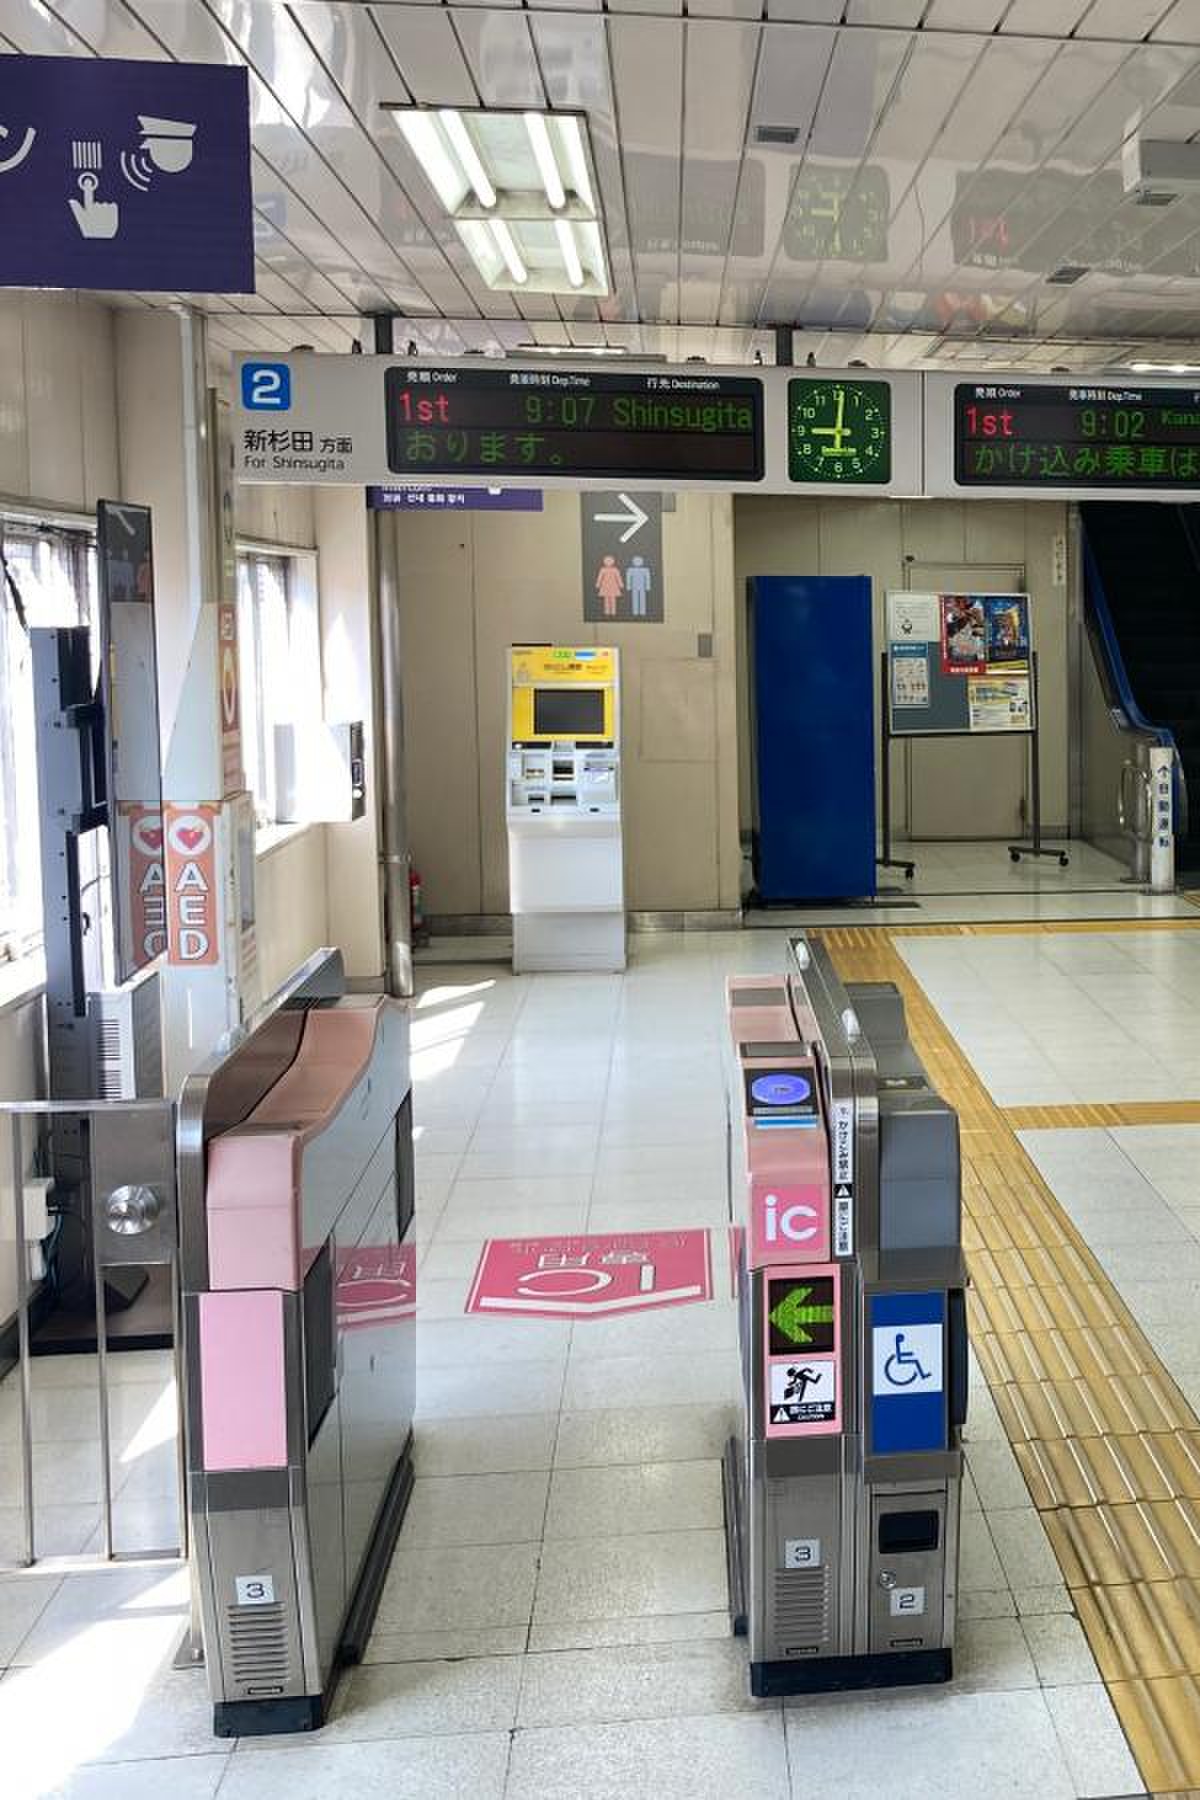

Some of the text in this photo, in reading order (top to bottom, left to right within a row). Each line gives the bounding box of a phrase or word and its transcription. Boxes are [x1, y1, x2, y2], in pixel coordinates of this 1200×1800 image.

[252, 369, 281, 404] 2
[671, 379, 720, 390] Destination
[400, 391, 753, 432] 1st 9:07 Shinsugita
[967, 407, 1013, 436] 1st
[1081, 410, 1145, 438] 9:02
[244, 430, 352, 454] 新杉田 方面
[406, 430, 562, 465] おります。
[244, 455, 345, 472] For Shinsugita
[175, 863, 209, 960] AED
[794, 1546, 811, 1561] 3
[246, 1584, 264, 1599] 3
[899, 1594, 915, 1609] 2
